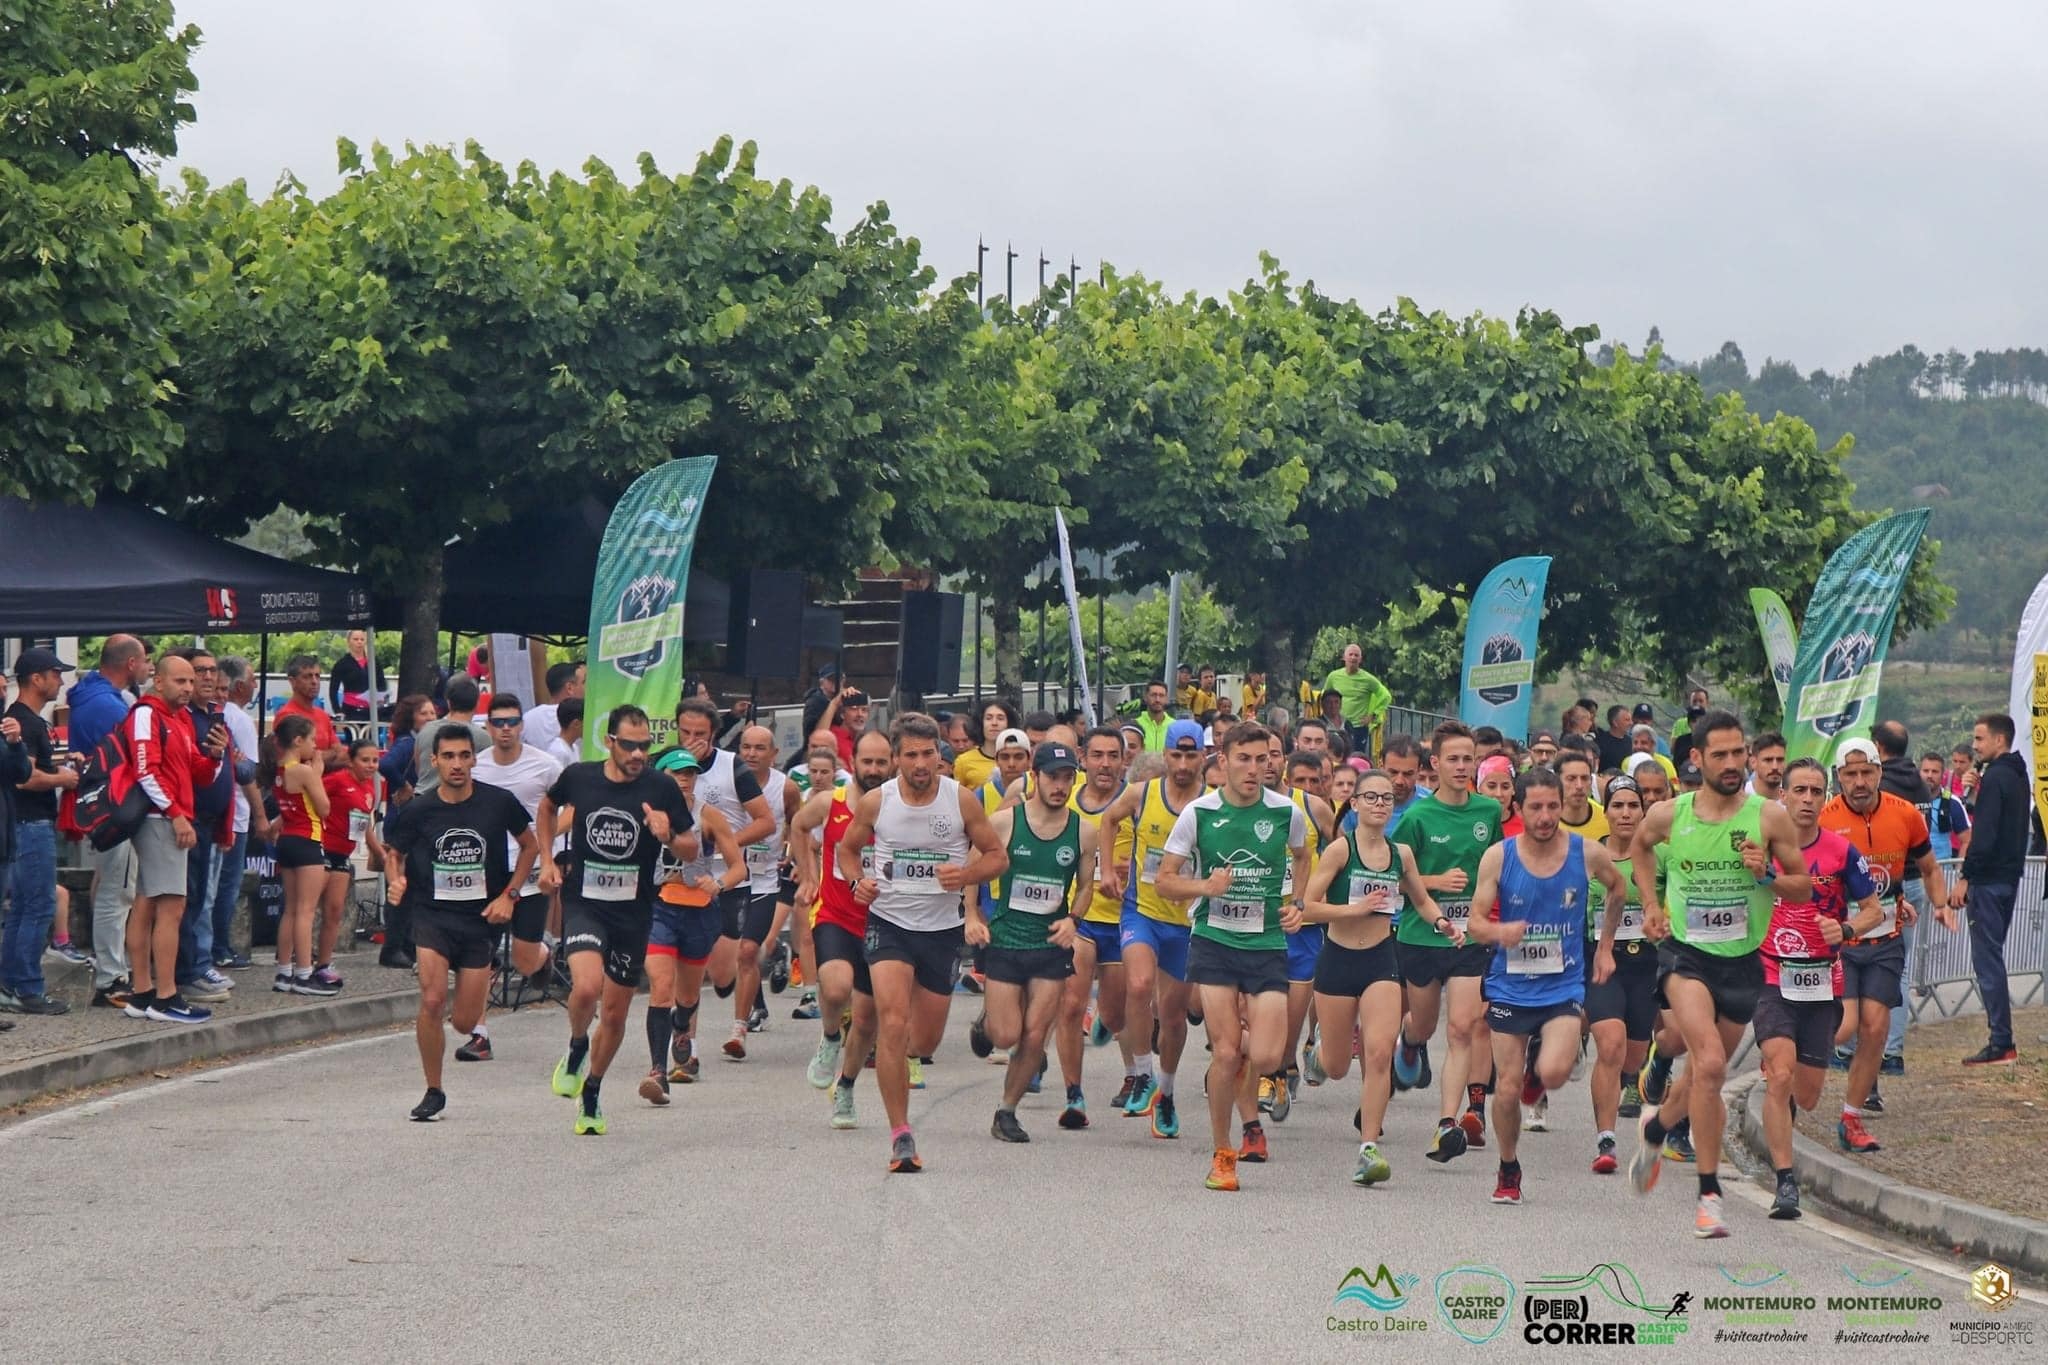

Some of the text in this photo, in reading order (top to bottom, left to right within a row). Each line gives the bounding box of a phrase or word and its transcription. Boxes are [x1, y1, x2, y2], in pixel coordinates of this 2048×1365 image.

[591, 828, 633, 841] CASTRO
[443, 847, 481, 858] CASTRO
[906, 864, 935, 879] 034
[447, 875, 472, 888] 150
[597, 874, 624, 889] 071
[1024, 885, 1050, 901] 091
[1222, 904, 1250, 918] 017
[1446, 905, 1470, 919] 092
[1702, 912, 1733, 927] 149
[1520, 945, 1548, 961] 190
[1793, 973, 1820, 987] 068
